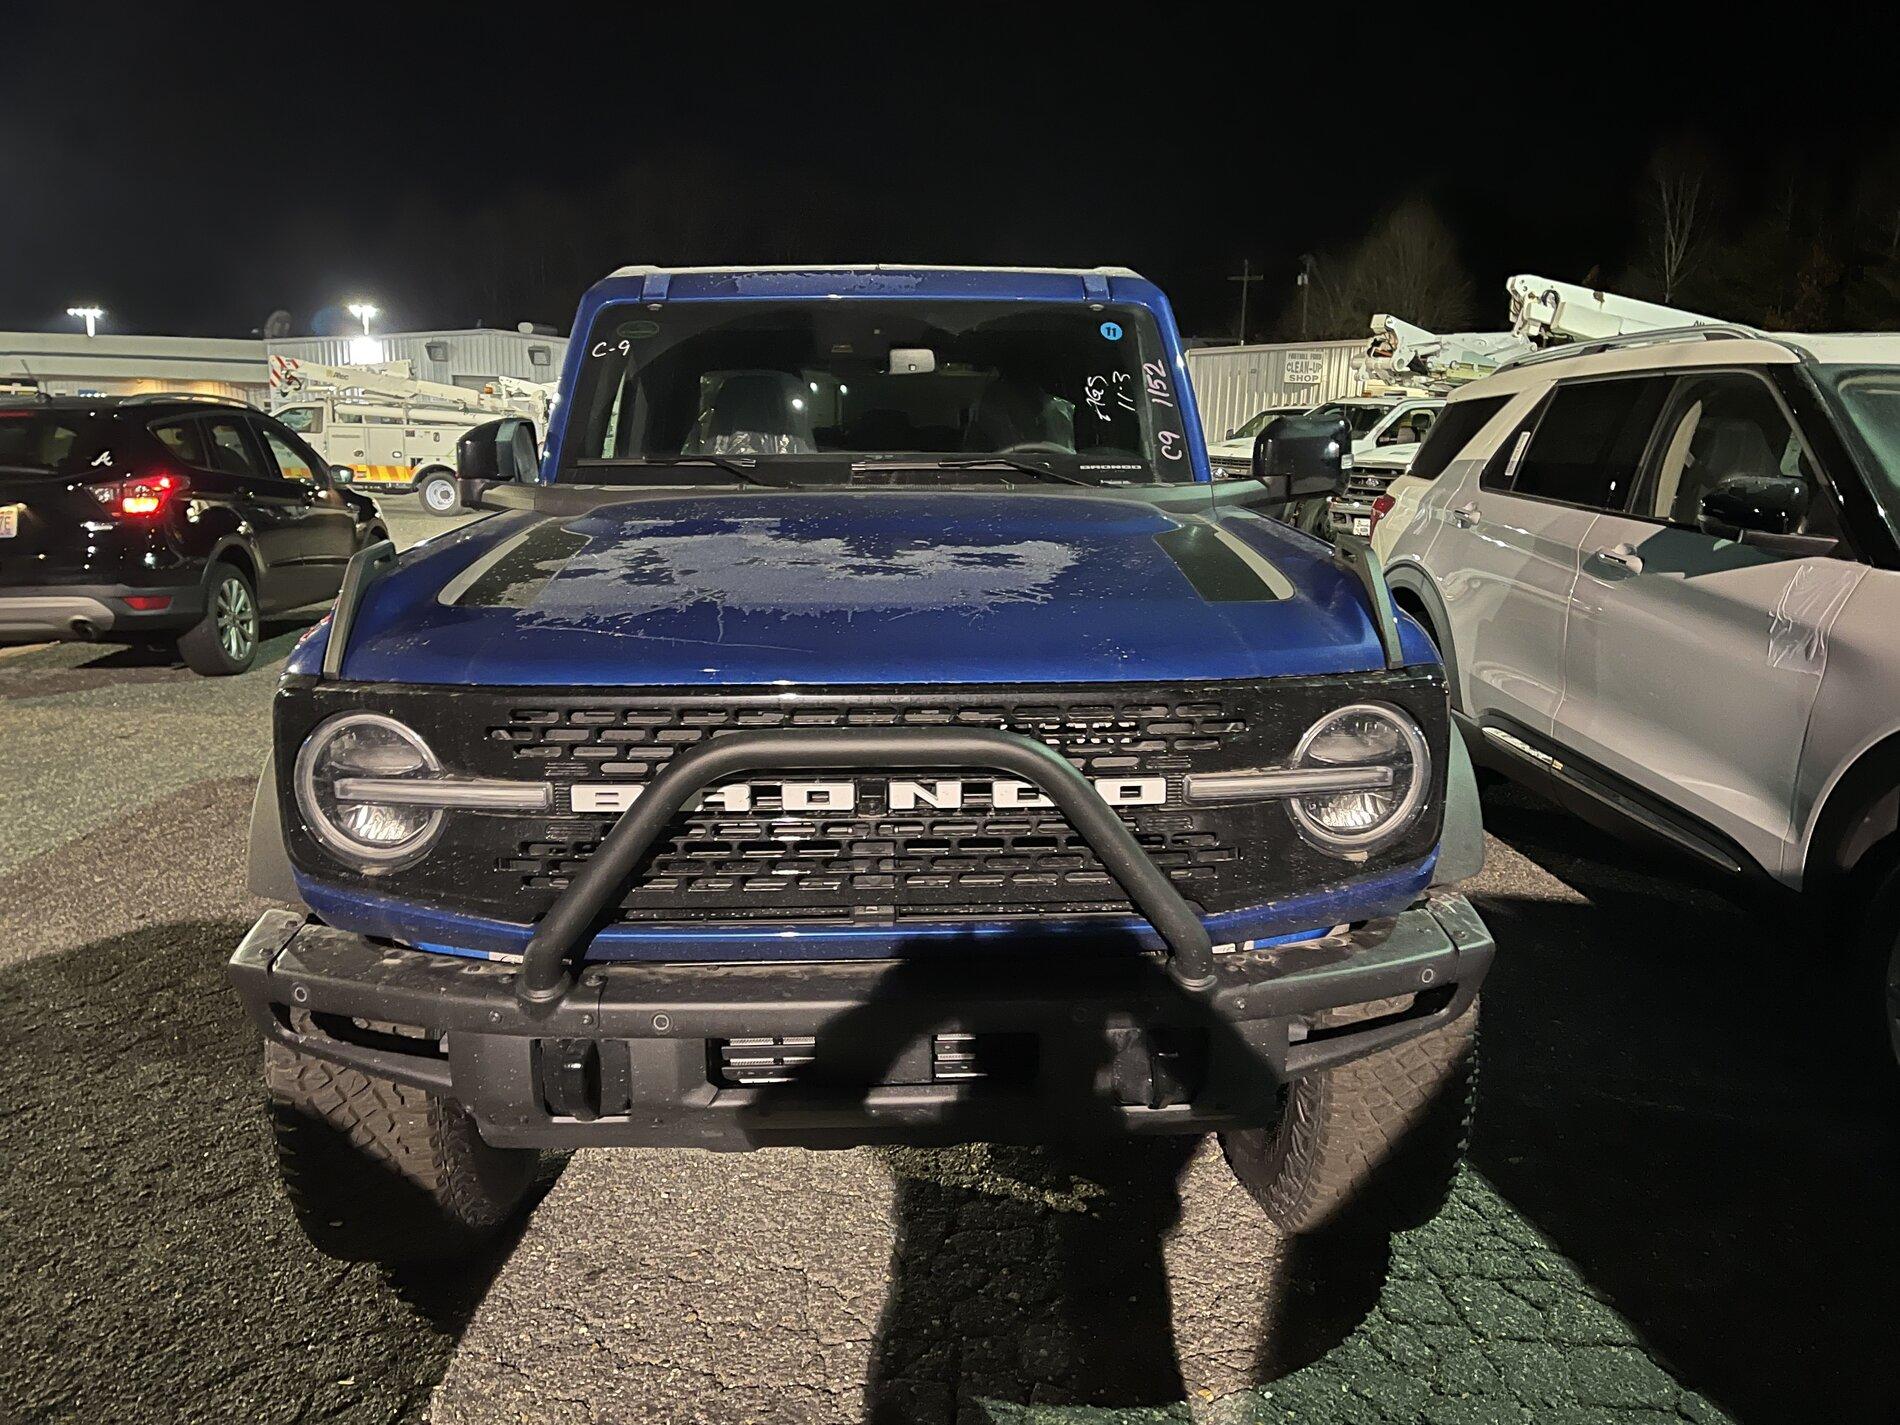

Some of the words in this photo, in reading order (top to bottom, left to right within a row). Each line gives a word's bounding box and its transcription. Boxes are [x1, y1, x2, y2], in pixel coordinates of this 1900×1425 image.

[591, 339, 631, 358] C-9
[1286, 360, 1323, 374] CLEAN-UP
[1289, 374, 1320, 382] SHOP
